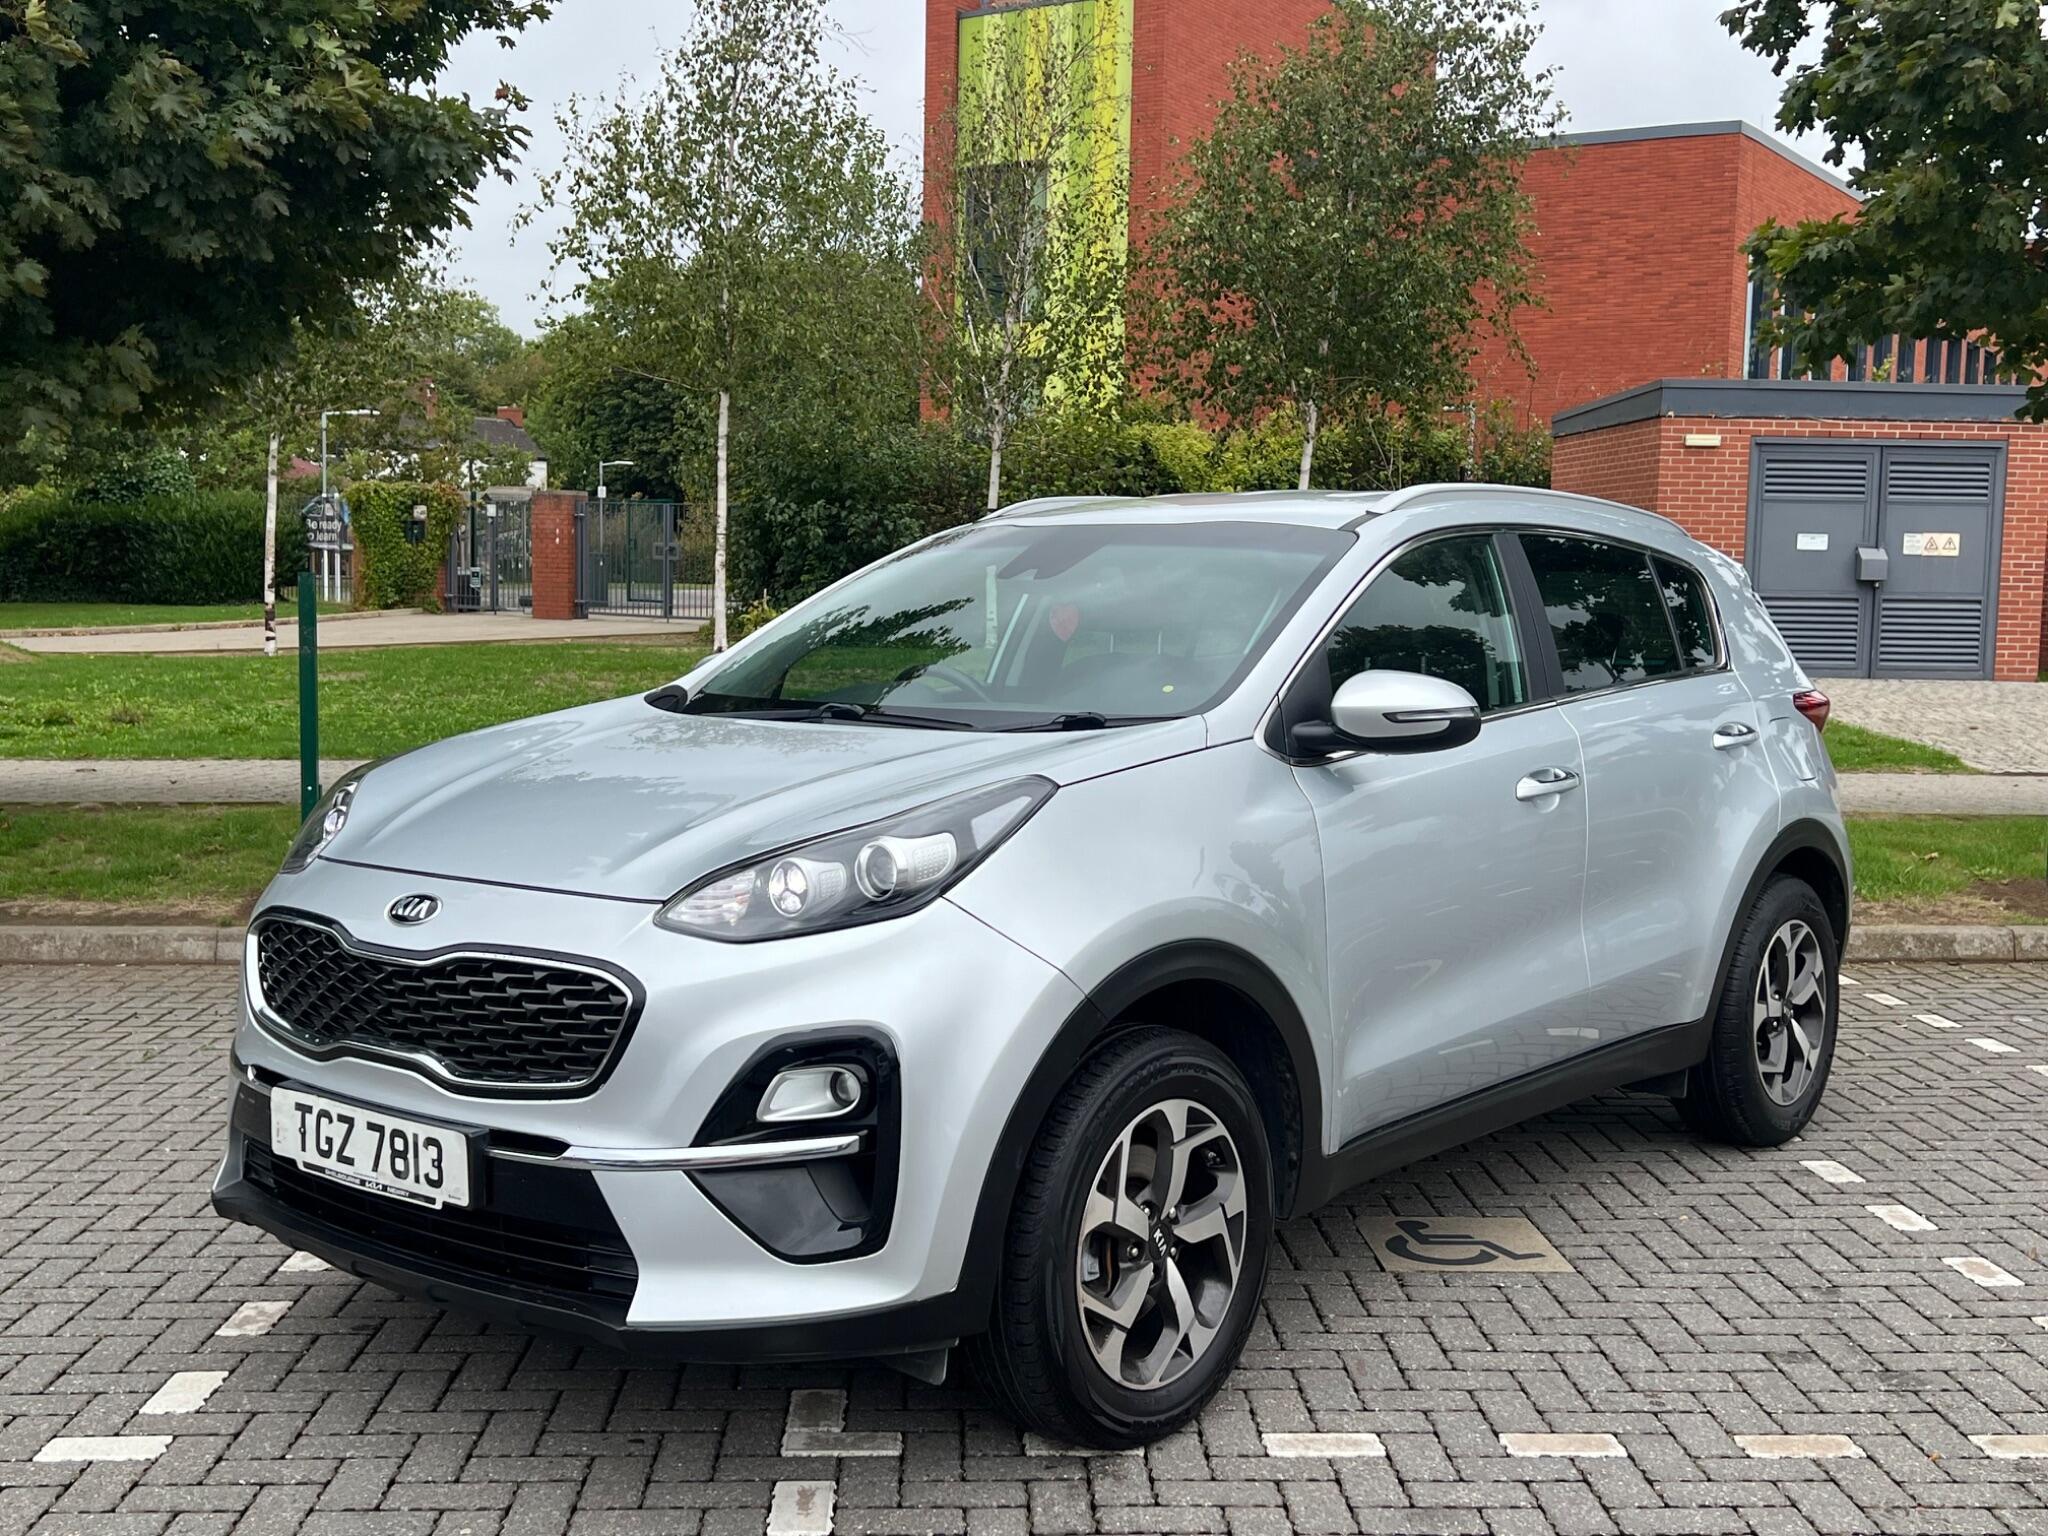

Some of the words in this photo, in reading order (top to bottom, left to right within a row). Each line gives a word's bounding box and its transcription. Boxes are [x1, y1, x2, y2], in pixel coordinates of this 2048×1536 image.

[316, 530, 337, 541] learn
[319, 519, 342, 532] ready
[391, 897, 432, 919] KIA
[294, 1102, 355, 1167] TGZ
[366, 1121, 444, 1189] 7813
[1153, 1227, 1167, 1256] KIA
